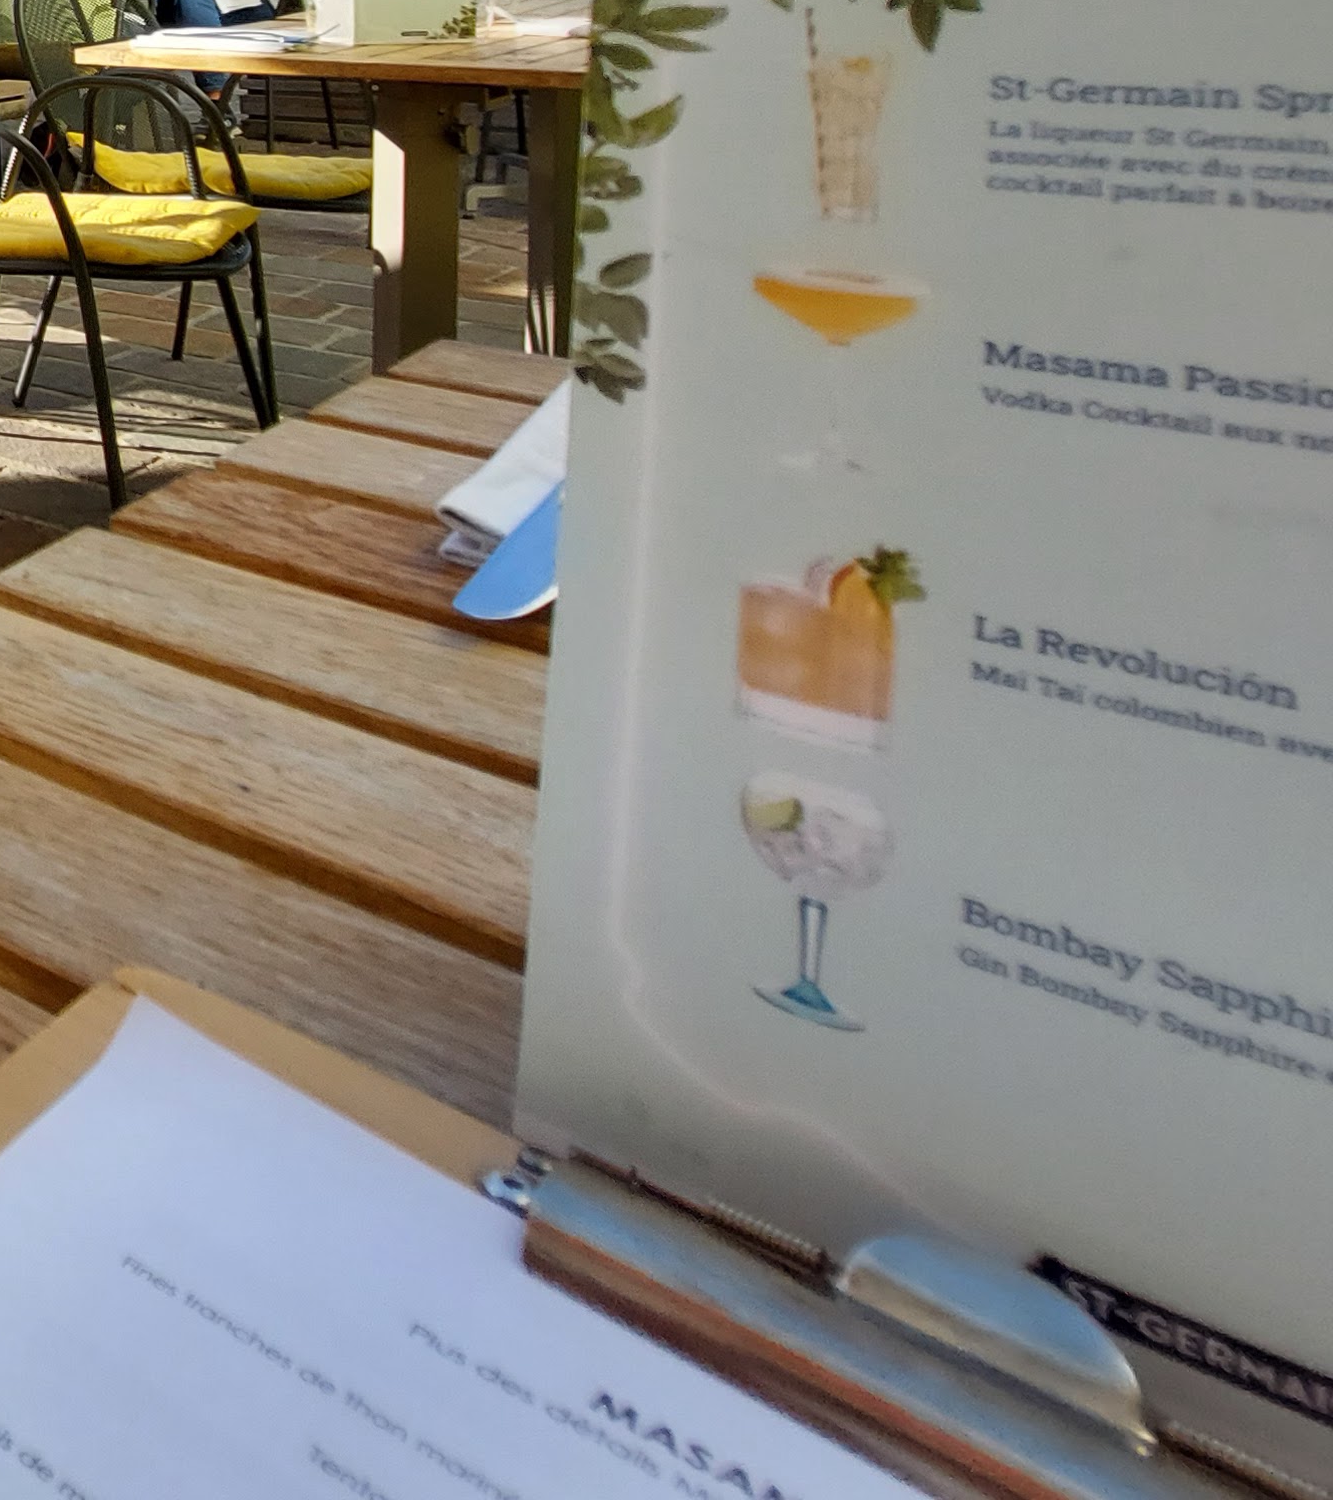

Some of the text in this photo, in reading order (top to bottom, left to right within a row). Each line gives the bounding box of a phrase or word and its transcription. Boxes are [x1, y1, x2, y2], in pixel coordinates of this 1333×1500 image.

[989, 75, 1239, 110] St-Germain
[989, 120, 1022, 138] La
[983, 341, 1170, 388] Masama
[981, 385, 1074, 417] Vodka
[1082, 399, 1213, 437] Cocktail
[974, 614, 1300, 712] La Revolución
[1093, 696, 1268, 748] colombien
[961, 897, 1144, 983] Bombay
[959, 946, 1319, 1080] Gin Bombay Sapphire
[122, 1255, 178, 1298] Fines
[184, 1293, 293, 1371] tranches
[297, 1368, 337, 1395] de
[344, 1390, 409, 1442] thon
[408, 1321, 468, 1366] Plus
[18, 1451, 55, 1483] de
